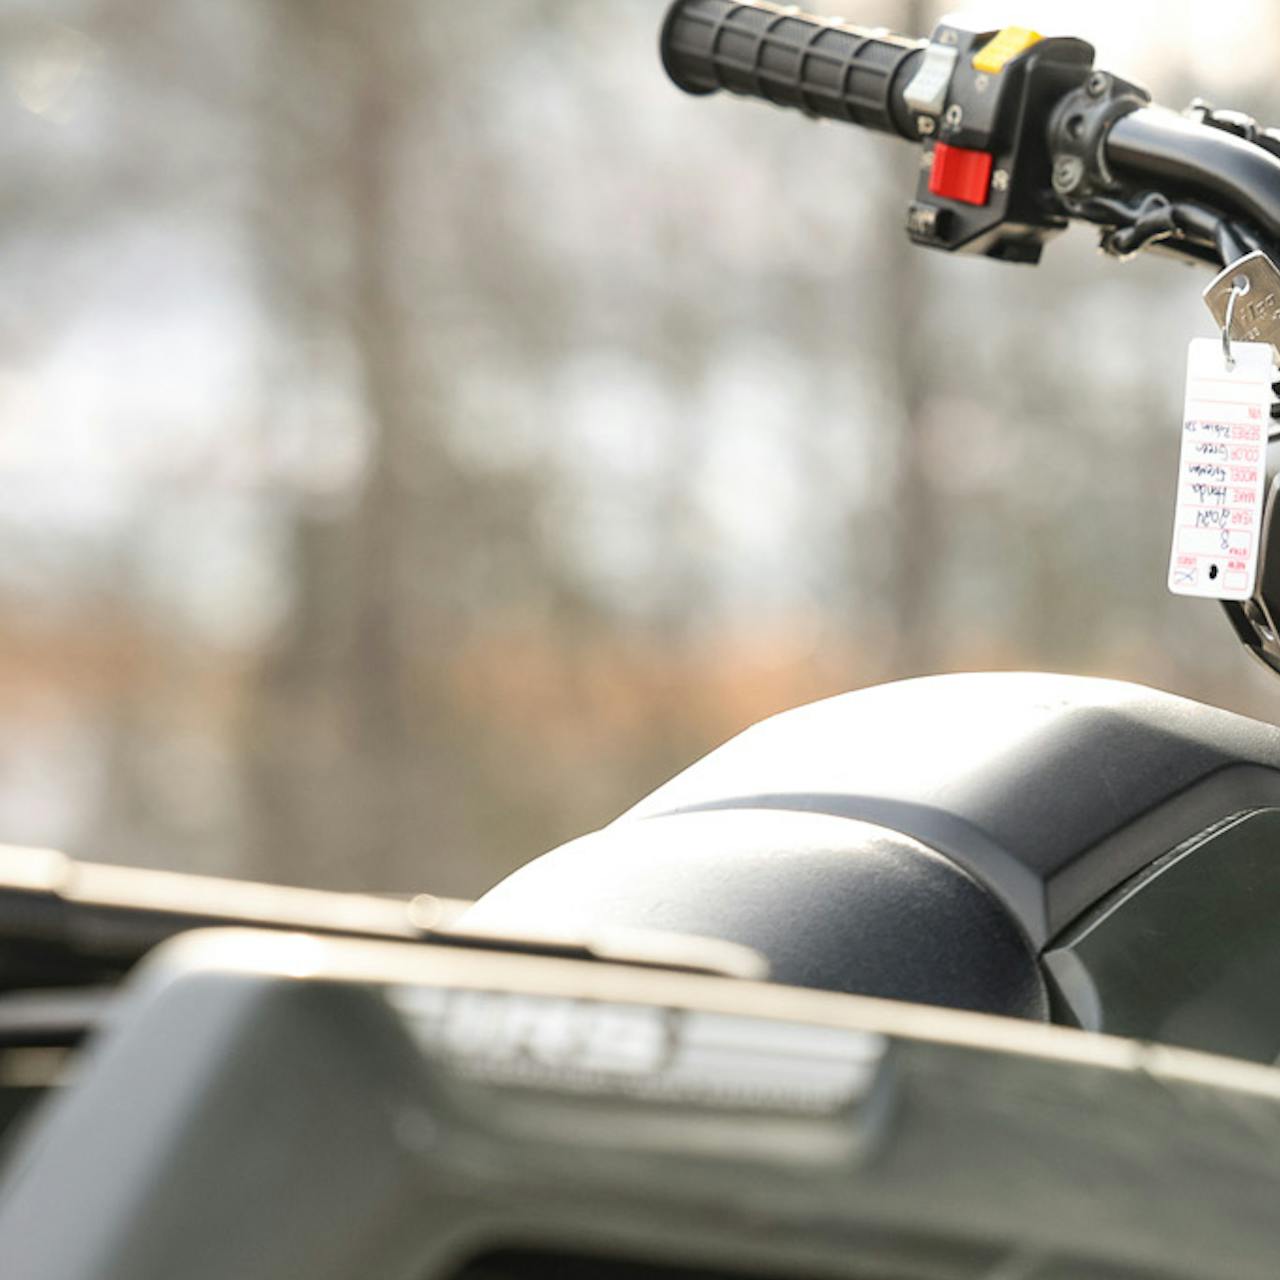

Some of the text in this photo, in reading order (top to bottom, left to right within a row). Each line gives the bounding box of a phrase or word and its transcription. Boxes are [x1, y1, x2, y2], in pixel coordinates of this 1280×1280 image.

[1231, 447, 1260, 462] COLOR
[1231, 466, 1257, 482] MODEL
[1191, 483, 1227, 505] Honda
[1231, 489, 1256, 503] MAKE
[1231, 511, 1253, 525] YEAR
[1227, 560, 1246, 569] NEW
